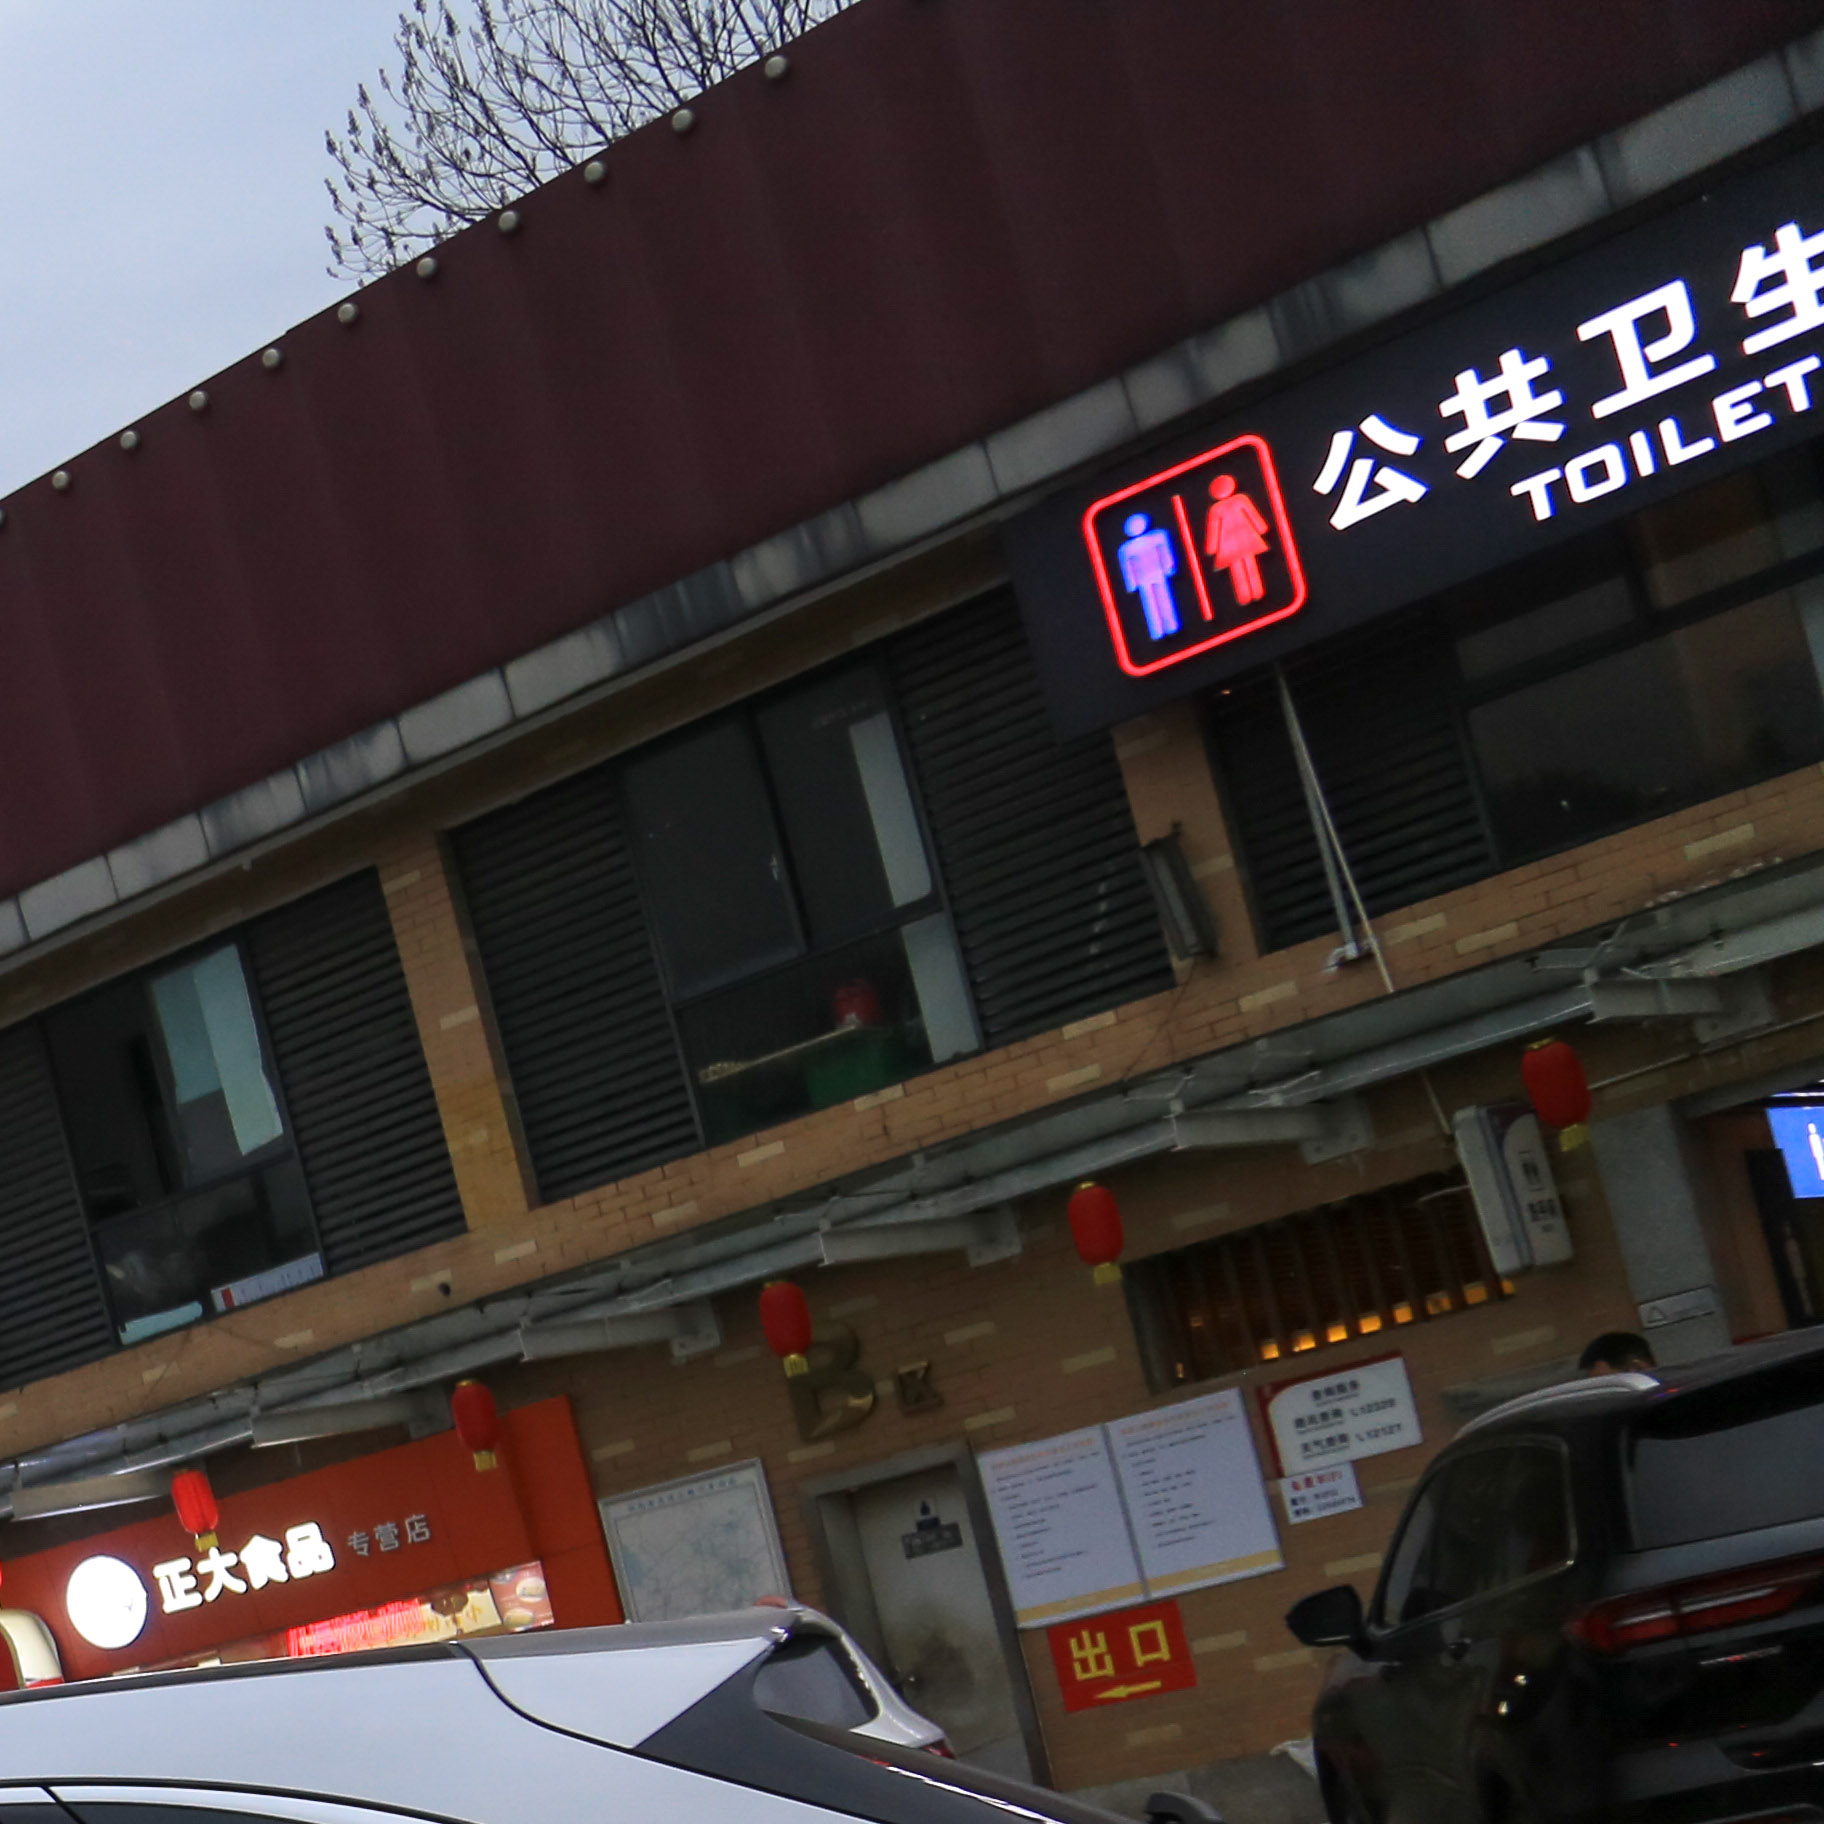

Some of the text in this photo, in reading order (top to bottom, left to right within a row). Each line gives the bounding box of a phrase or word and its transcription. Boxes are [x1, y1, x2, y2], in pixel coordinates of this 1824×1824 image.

[1510, 355, 1823, 522] TOILET
[152, 1513, 432, 1616] 正大食品 专营店
[1067, 1618, 1171, 1684] 出口
